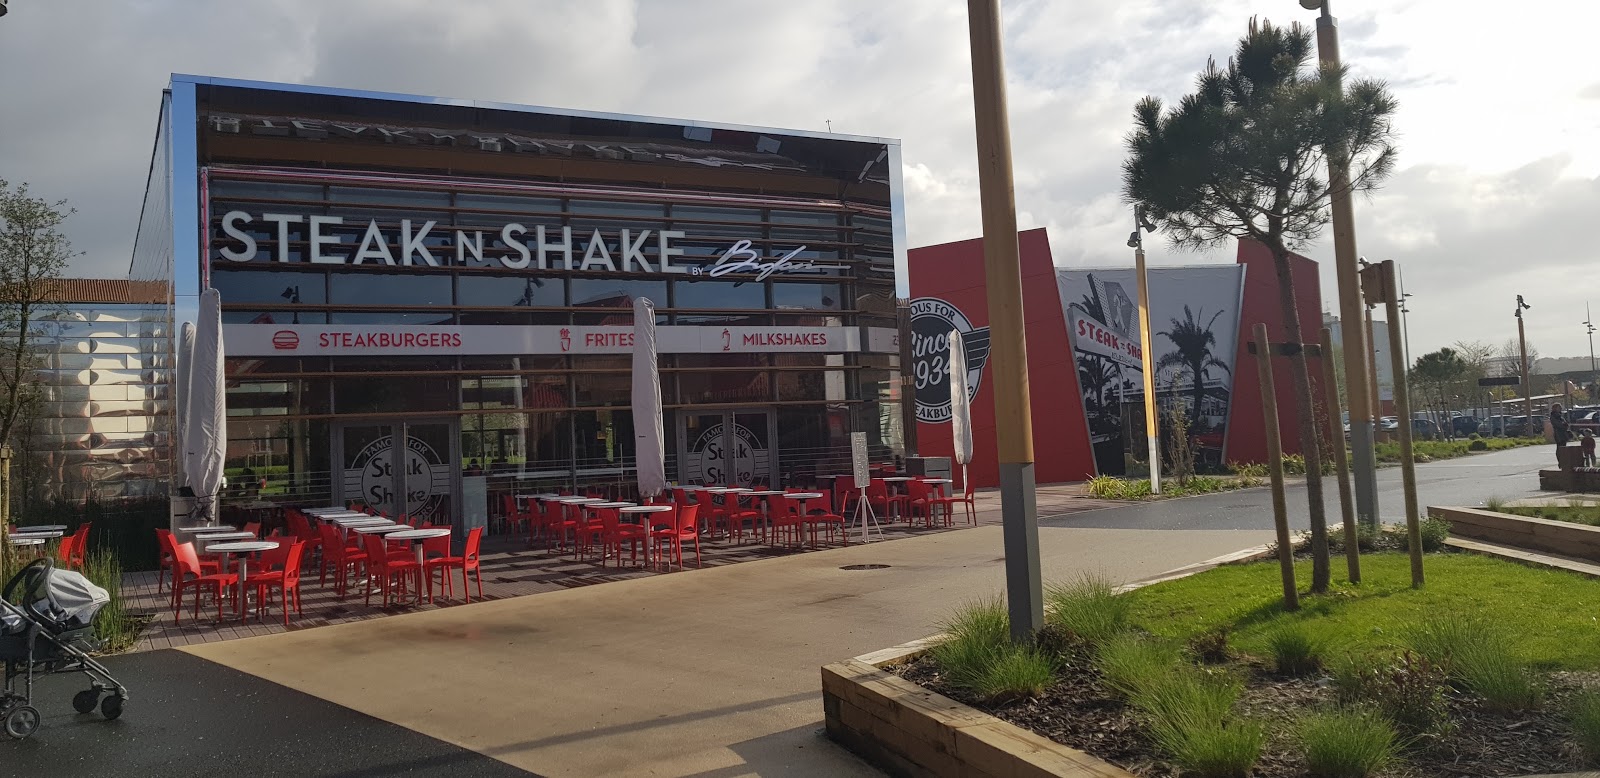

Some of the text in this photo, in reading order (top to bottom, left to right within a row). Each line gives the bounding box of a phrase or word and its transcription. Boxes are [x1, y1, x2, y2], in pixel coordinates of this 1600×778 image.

[219, 210, 688, 273] STEAK N SHAKE
[692, 267, 704, 276] BY
[911, 303, 955, 320] OUS FOR
[319, 332, 462, 348] STEAKBURGERS
[585, 333, 634, 347] FRITES
[742, 332, 828, 347] MILKSHAKES
[1077, 319, 1119, 351] STEAK
[1126, 342, 1142, 361] SHA
[736, 428, 751, 440] FOR
[365, 439, 427, 456] FAMO FOR
[708, 467, 750, 484] Shke
[370, 485, 426, 505] Shke
